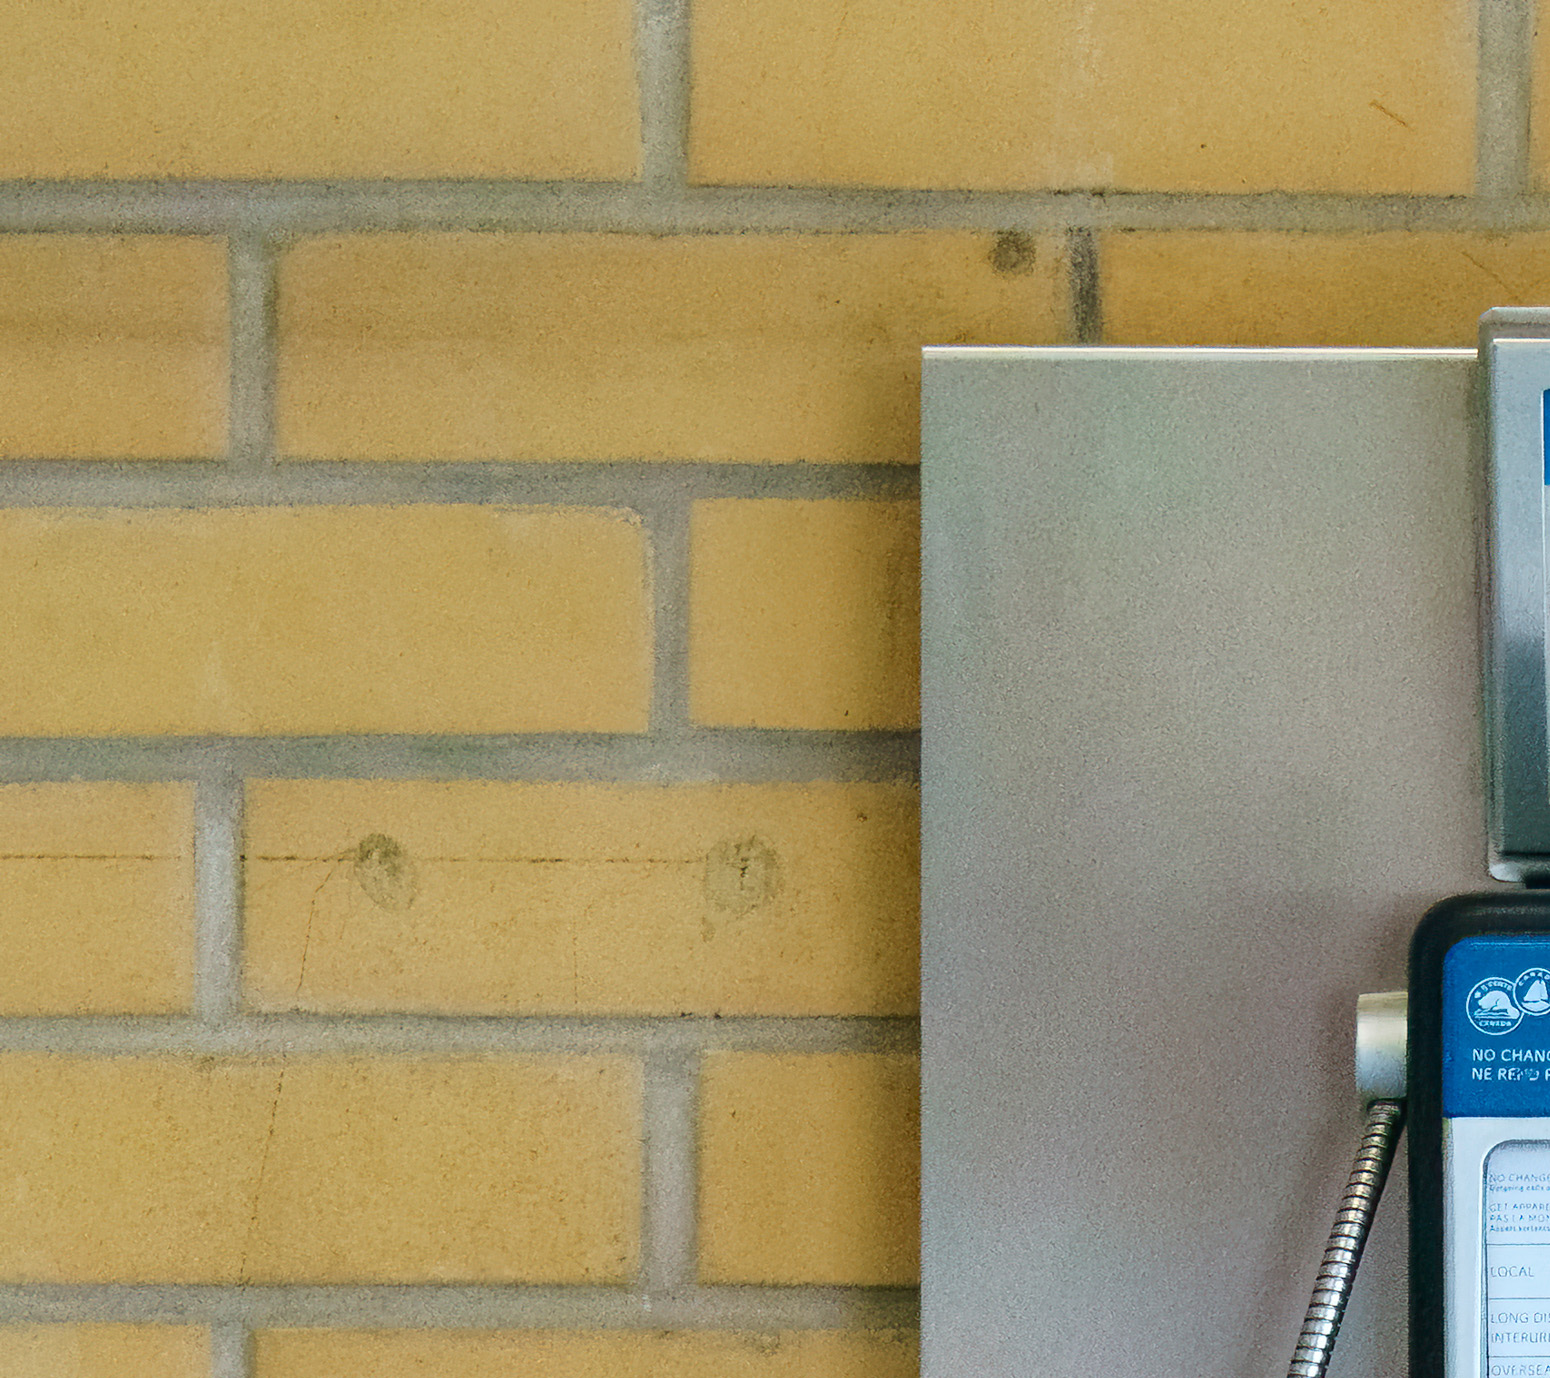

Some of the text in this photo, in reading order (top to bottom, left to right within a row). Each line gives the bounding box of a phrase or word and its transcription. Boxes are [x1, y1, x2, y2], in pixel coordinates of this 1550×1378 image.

[1472, 1048, 1496, 1062] NO
[1472, 1068, 1492, 1080] NE
[1491, 1266, 1535, 1277] LOCAL
[1490, 1312, 1529, 1323] LONG
